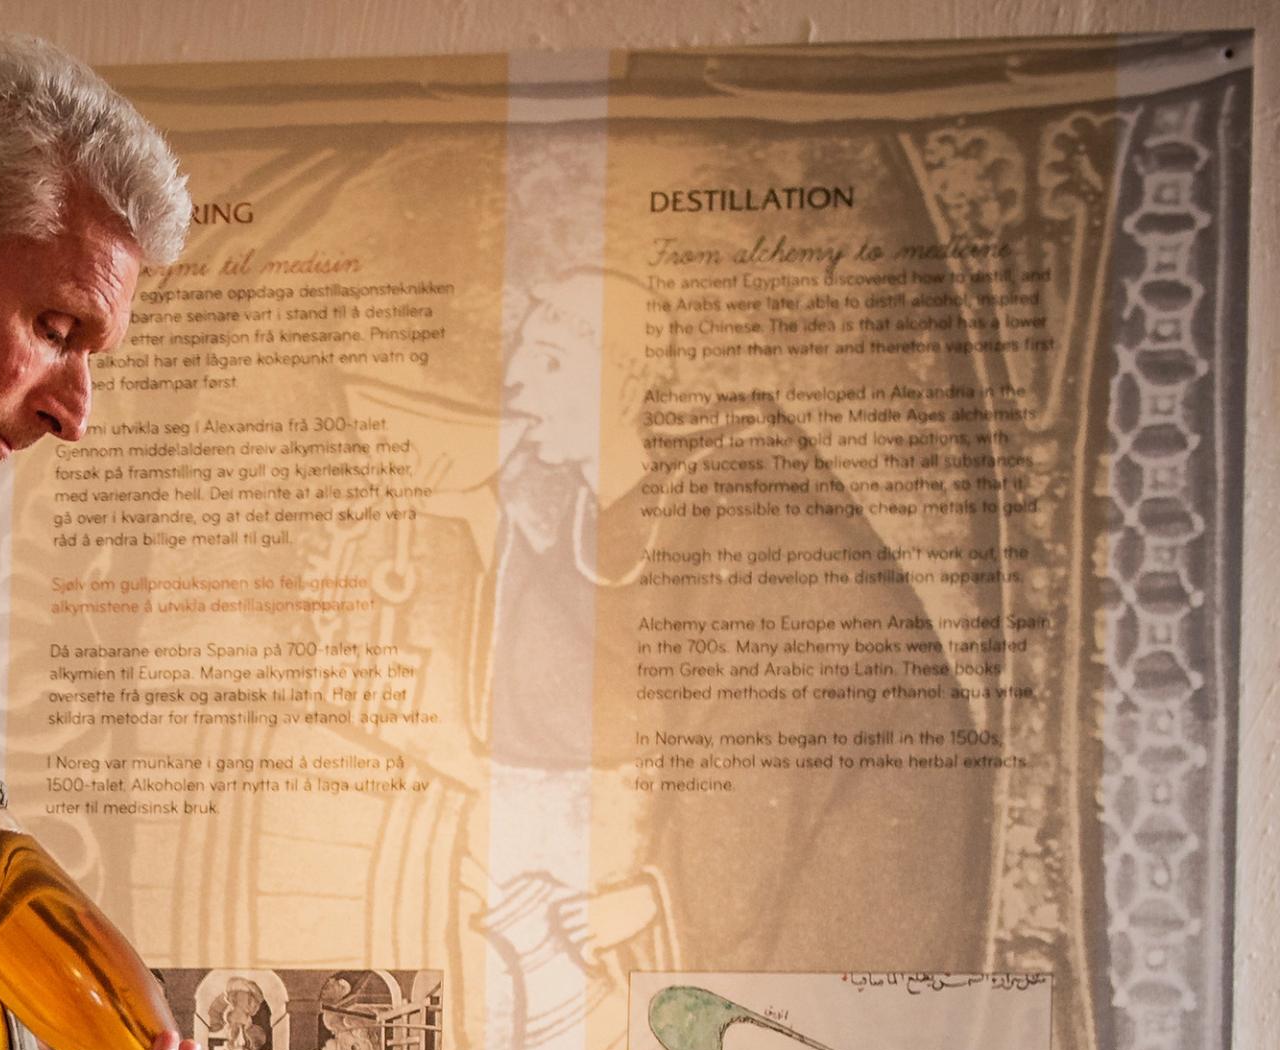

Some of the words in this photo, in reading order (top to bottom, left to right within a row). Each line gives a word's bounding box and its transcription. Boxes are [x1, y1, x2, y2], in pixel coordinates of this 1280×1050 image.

[650, 186, 854, 212] DESTILLATION
[261, 250, 361, 274] medisin
[648, 237, 721, 266] From
[733, 235, 846, 278] alchemy
[853, 237, 884, 262] to
[648, 275, 675, 289] The
[681, 275, 736, 289] ancient
[744, 273, 818, 291] Egyptians
[824, 271, 906, 286] discovered
[228, 283, 294, 302] oppdaga
[286, 306, 327, 320] stand
[365, 304, 432, 319] destillera
[676, 297, 720, 311] Arabs
[669, 320, 693, 334] the
[769, 318, 798, 333] The
[860, 316, 889, 331] that
[170, 330, 249, 348] inspirasjon
[370, 326, 446, 344] Prinsippet
[702, 343, 742, 360] point
[747, 341, 782, 356] than
[788, 342, 829, 355] water
[835, 339, 864, 354] and
[154, 353, 178, 368] har
[206, 352, 252, 370] lågare
[257, 351, 334, 369] kokepunkt
[340, 354, 367, 365] enn
[372, 351, 404, 364] vatn
[120, 375, 198, 393] fordampar
[644, 387, 710, 405] Alchemy
[786, 385, 866, 403] developed
[690, 410, 718, 425] and
[818, 409, 842, 423] the
[849, 408, 900, 423] Middle
[906, 408, 945, 426] Ages
[112, 420, 159, 435] utvikla
[164, 424, 190, 438] seg
[204, 419, 282, 433] Alexandria
[56, 444, 124, 461] Gjennom
[129, 442, 235, 456] middelalderen
[240, 441, 276, 455] dreiv
[280, 439, 370, 458] alkymistane
[376, 438, 410, 453] med
[798, 432, 831, 450] gold
[838, 431, 866, 446] and
[874, 431, 904, 445] love
[56, 465, 99, 480] forsøk
[128, 464, 212, 482] framstilling
[239, 463, 266, 481] gull
[642, 457, 696, 474] varying
[772, 455, 808, 473] They
[814, 454, 878, 469] believed
[884, 454, 914, 468] that
[55, 487, 87, 502] med
[92, 486, 169, 501] varierande
[316, 484, 342, 498] alle
[642, 480, 683, 494] could
[714, 478, 808, 493] transformed
[816, 479, 844, 492] into
[850, 481, 879, 492] one
[77, 514, 107, 524] over
[246, 507, 269, 522] det
[275, 507, 332, 522] dermed
[338, 506, 380, 521] skulle
[640, 502, 686, 517] would
[716, 501, 780, 520] possible
[806, 501, 864, 519] change
[870, 500, 917, 518] cheap
[924, 499, 976, 514] metals
[96, 532, 138, 546] endra
[143, 531, 186, 549] billige
[192, 530, 238, 545] metall
[642, 547, 711, 565] Although
[718, 547, 742, 562] the
[748, 547, 780, 565] gold
[787, 546, 871, 564] production
[928, 546, 962, 560] work
[91, 581, 115, 591] om
[640, 570, 722, 585] alchemists
[758, 570, 818, 588] develop
[824, 570, 848, 584] the
[638, 617, 706, 635] Alchemy
[712, 621, 755, 631] came
[781, 617, 836, 634] Europe
[840, 616, 881, 631] when
[888, 616, 932, 630] Arabs
[75, 643, 149, 658] arabarane
[154, 643, 201, 658] erobra
[207, 643, 258, 661] Spania
[366, 641, 398, 656] kom
[658, 639, 682, 654] the
[736, 640, 778, 657] Many
[784, 638, 849, 657] alchemy
[856, 638, 900, 653] books
[906, 642, 942, 653] were
[50, 666, 115, 684] alkymien
[200, 666, 250, 683] Mange
[256, 665, 346, 683] alkymistiske
[638, 662, 674, 677] from
[680, 662, 724, 677] Greek
[730, 662, 758, 677] and
[764, 662, 814, 676] Arabic
[820, 663, 849, 676] into
[902, 661, 949, 676] These
[955, 661, 1000, 676] books
[48, 689, 115, 702] oversette
[145, 687, 184, 705] gresk
[214, 687, 267, 702] arabisk
[332, 687, 356, 701] Her
[383, 686, 406, 701] det
[636, 685, 711, 700] described
[718, 685, 786, 700] methods
[813, 686, 876, 703] creating
[48, 710, 95, 725] skildra
[102, 710, 163, 725] metodar
[194, 710, 278, 728] framstilling
[360, 714, 397, 728] aqua
[720, 731, 772, 746] monks
[778, 731, 826, 749] began
[854, 731, 894, 746] distill
[920, 731, 944, 746] the
[56, 755, 100, 773] Noreg
[105, 759, 128, 769] var
[132, 755, 202, 769] munkane
[216, 759, 253, 773] gang
[260, 755, 293, 769] med
[313, 754, 380, 769] destillera
[635, 754, 664, 769] and
[671, 754, 694, 769] the
[700, 754, 755, 769] alcohol
[761, 758, 790, 769] was
[796, 754, 832, 769] used
[860, 754, 902, 769] make
[908, 754, 958, 769] herbal
[132, 778, 204, 792] Alkoholen
[210, 779, 236, 792] vart
[243, 779, 280, 796] nytta
[318, 778, 349, 796] laga
[46, 801, 80, 814] urter
[104, 800, 178, 814] medisinsk
